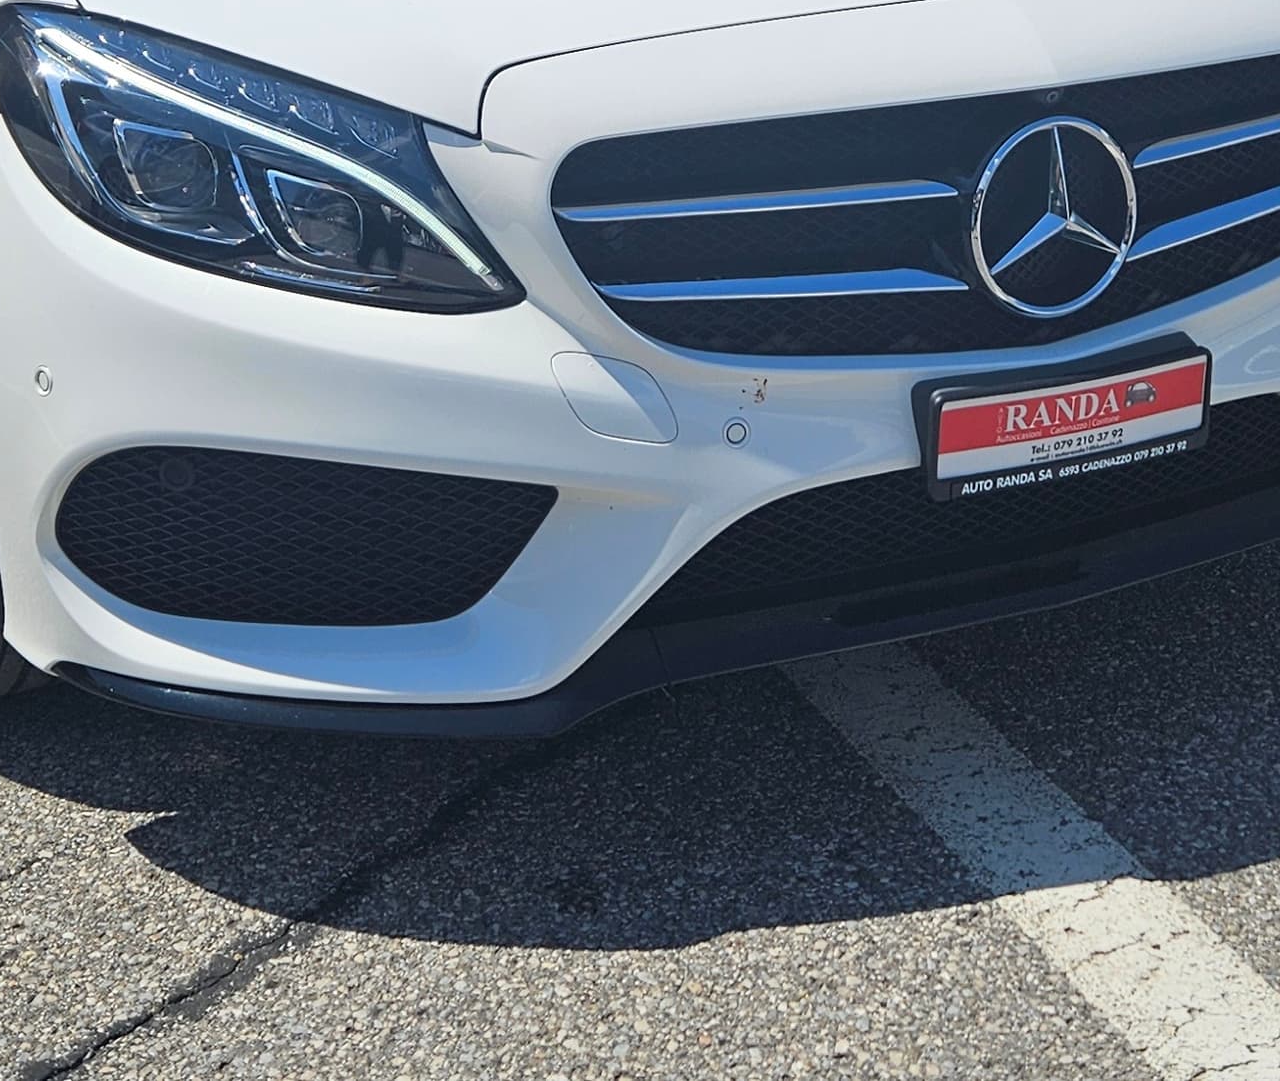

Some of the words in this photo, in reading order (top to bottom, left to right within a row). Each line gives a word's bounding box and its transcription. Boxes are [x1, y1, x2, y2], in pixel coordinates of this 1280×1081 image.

[1004, 388, 1120, 432] RANDA
[1053, 439, 1074, 451] 079
[1076, 434, 1095, 447] 210
[1097, 431, 1109, 442] 37
[1111, 427, 1124, 438] 92
[961, 478, 994, 496] AUTO
[995, 471, 1036, 489] RANDA
[1037, 468, 1054, 482] SA
[1058, 464, 1080, 478] 6593
[1081, 453, 1133, 473] CADENAZZO
[1133, 448, 1149, 461] 079
[1150, 445, 1165, 458] 210
[1165, 442, 1176, 454] 37
[1176, 439, 1188, 451] 92
